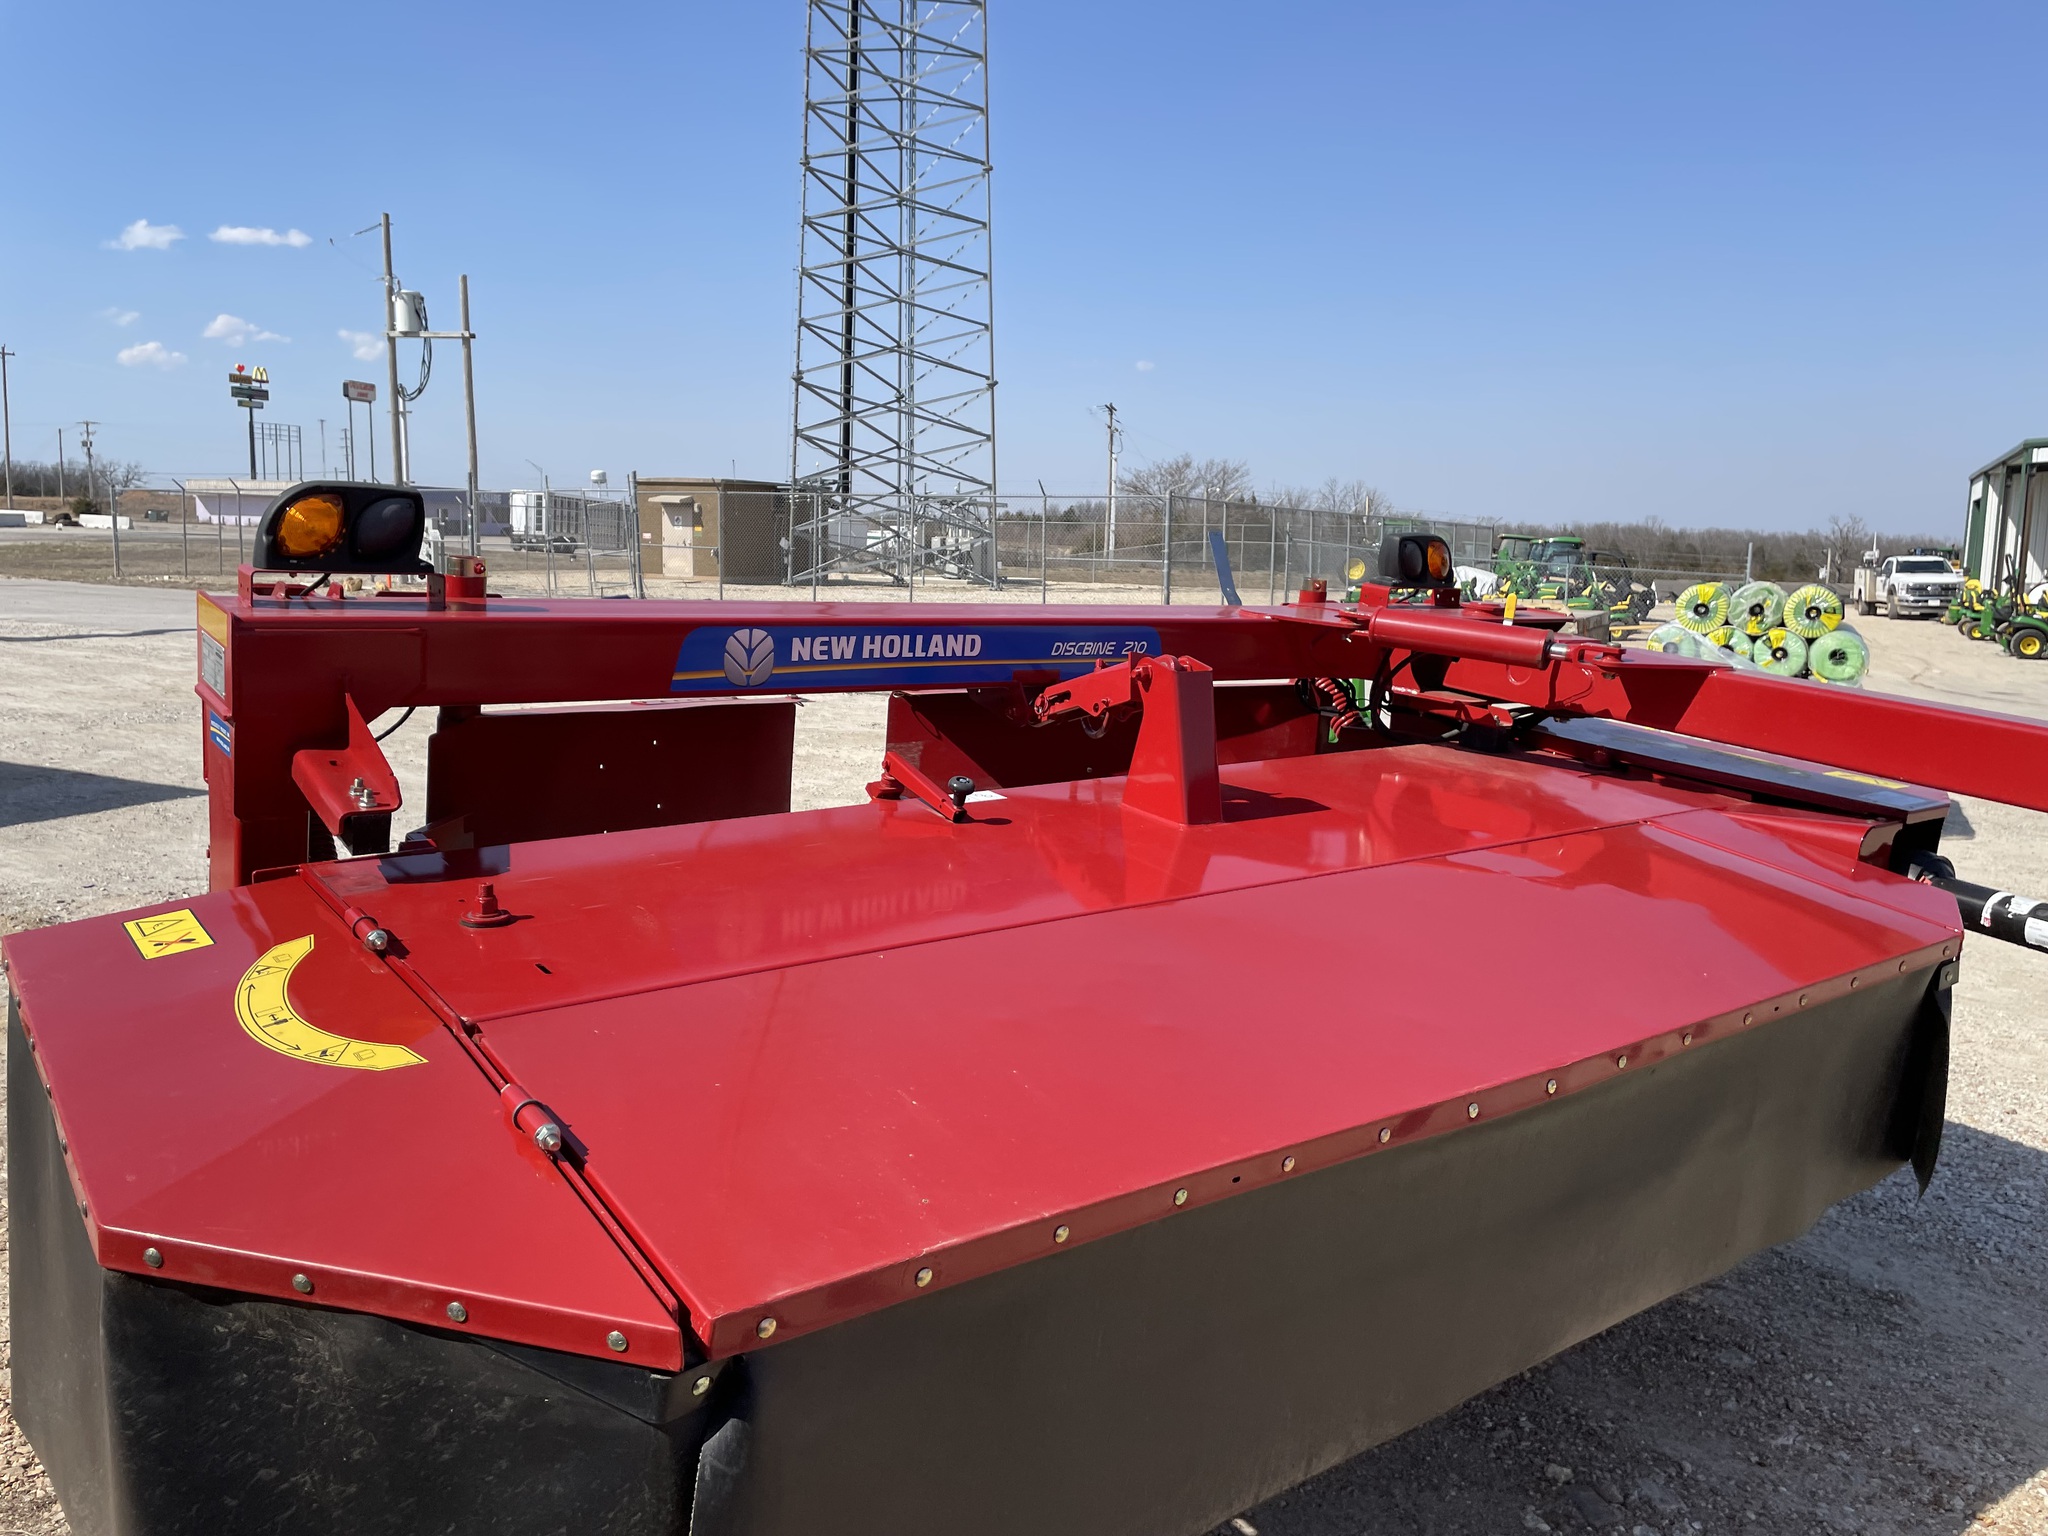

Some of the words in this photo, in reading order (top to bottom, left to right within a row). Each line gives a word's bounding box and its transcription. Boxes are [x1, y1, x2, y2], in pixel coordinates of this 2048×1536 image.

[479, 493, 502, 504] ASURE
[791, 636, 857, 662] NEW
[861, 634, 982, 659] HOLLAND
[1050, 641, 1117, 656] DISCBINE
[1121, 641, 1148, 655] 210
